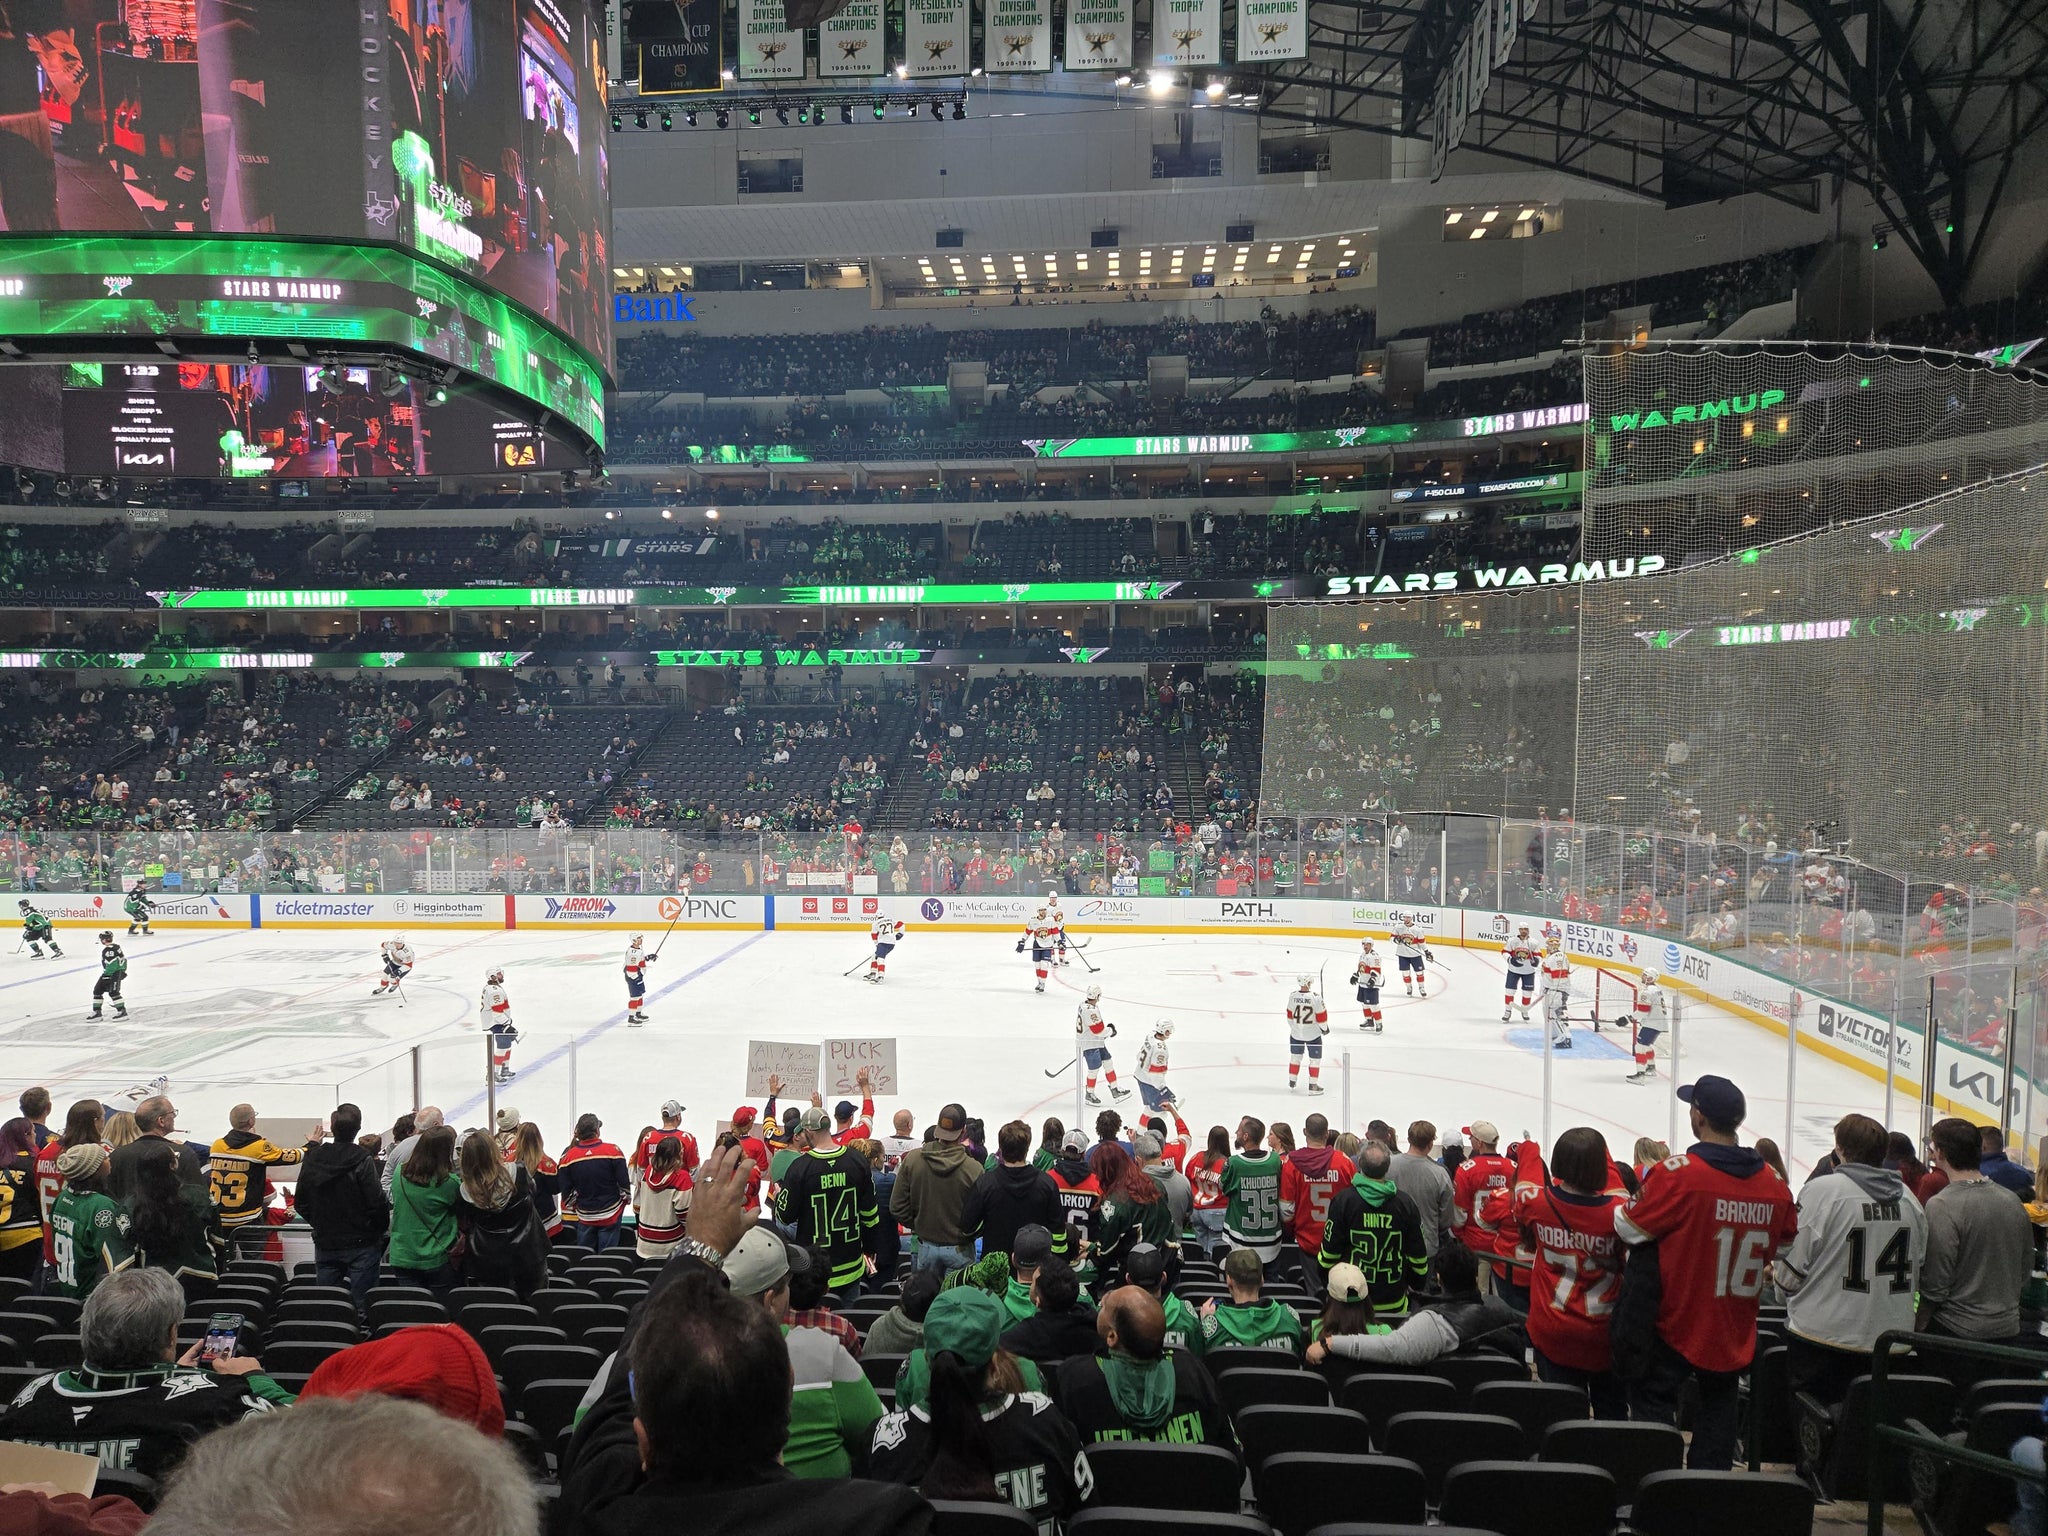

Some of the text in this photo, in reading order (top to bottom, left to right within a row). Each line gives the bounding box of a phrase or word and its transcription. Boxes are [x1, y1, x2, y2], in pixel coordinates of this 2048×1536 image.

[753, 8, 785, 20] DIVISIO
[1000, 0, 1037, 12] DIVISION
[1170, 0, 1204, 13] TROPHY
[1246, 1, 1298, 16] CHAMPIONS
[827, 18, 877, 32] CHAMPIONS
[921, 11, 954, 25] TROPHY
[993, 13, 1043, 27] CHAMPIONS
[1074, 11, 1125, 25] CHAMPIONS
[692, 24, 711, 38] CUP
[651, 42, 709, 57] CHAMPIONS
[359, 8, 384, 170] HOCKEY
[223, 280, 342, 300] STARS WARMUP
[614, 293, 697, 322] Bank
[1611, 389, 1785, 432] WARMUP
[1464, 414, 1515, 437] STARS
[1136, 437, 1249, 453] STARS WARMUP
[1424, 488, 1465, 497] F-150 CLUB
[1479, 479, 1544, 493] TEXASFORD.COM
[634, 544, 693, 553] STARS
[1327, 555, 1665, 595] STARS WARMUP
[246, 591, 347, 605] STARS WARMUP
[530, 589, 634, 605] STARS WARMUP
[819, 585, 925, 602] STARS WARMUP
[1720, 620, 1851, 644] STARS WARMUP
[2, 654, 40, 667] RMUP
[219, 654, 313, 668] STARS WARMUP
[656, 649, 921, 666] STARS WARMUP
[1555, 847, 1569, 858] 23
[275, 900, 374, 916] ticketmaster
[414, 903, 482, 913] Higginbotham
[561, 898, 606, 911] ARROW
[688, 900, 737, 918] PNC
[947, 901, 1027, 912] The McCauley Co.
[1103, 902, 1133, 911] DMG
[1221, 902, 1272, 916] PATH
[1352, 907, 1386, 920] ideal
[879, 922, 894, 935] 27
[1567, 924, 1614, 943] BEST IN
[1478, 932, 1509, 942] NHLSHO
[1568, 937, 1613, 957] TEXAS
[1683, 957, 1711, 981] AT&T
[1293, 1005, 1313, 1024] 42
[754, 1044, 773, 1058] All
[799, 1049, 814, 1060] Son
[831, 1041, 882, 1060] PUCK
[750, 1062, 773, 1073] Wants
[210, 1171, 248, 1207] 63
[821, 1172, 846, 1190] BENN
[1241, 1177, 1277, 1190] KHUDOBIN
[1487, 1175, 1507, 1188] JAGR
[1060, 1194, 1092, 1209] ARKOV
[1241, 1189, 1278, 1230] 35
[811, 1187, 860, 1248] 14
[1715, 1199, 1774, 1225] BARKOV
[1862, 1202, 1901, 1222] BENN
[1363, 1213, 1393, 1229] HINTZ
[54, 1234, 78, 1287] 91
[1350, 1230, 1403, 1285] 24
[1713, 1227, 1770, 1299] 16
[1842, 1227, 1912, 1295] 14
[1544, 1249, 1617, 1315] 72
